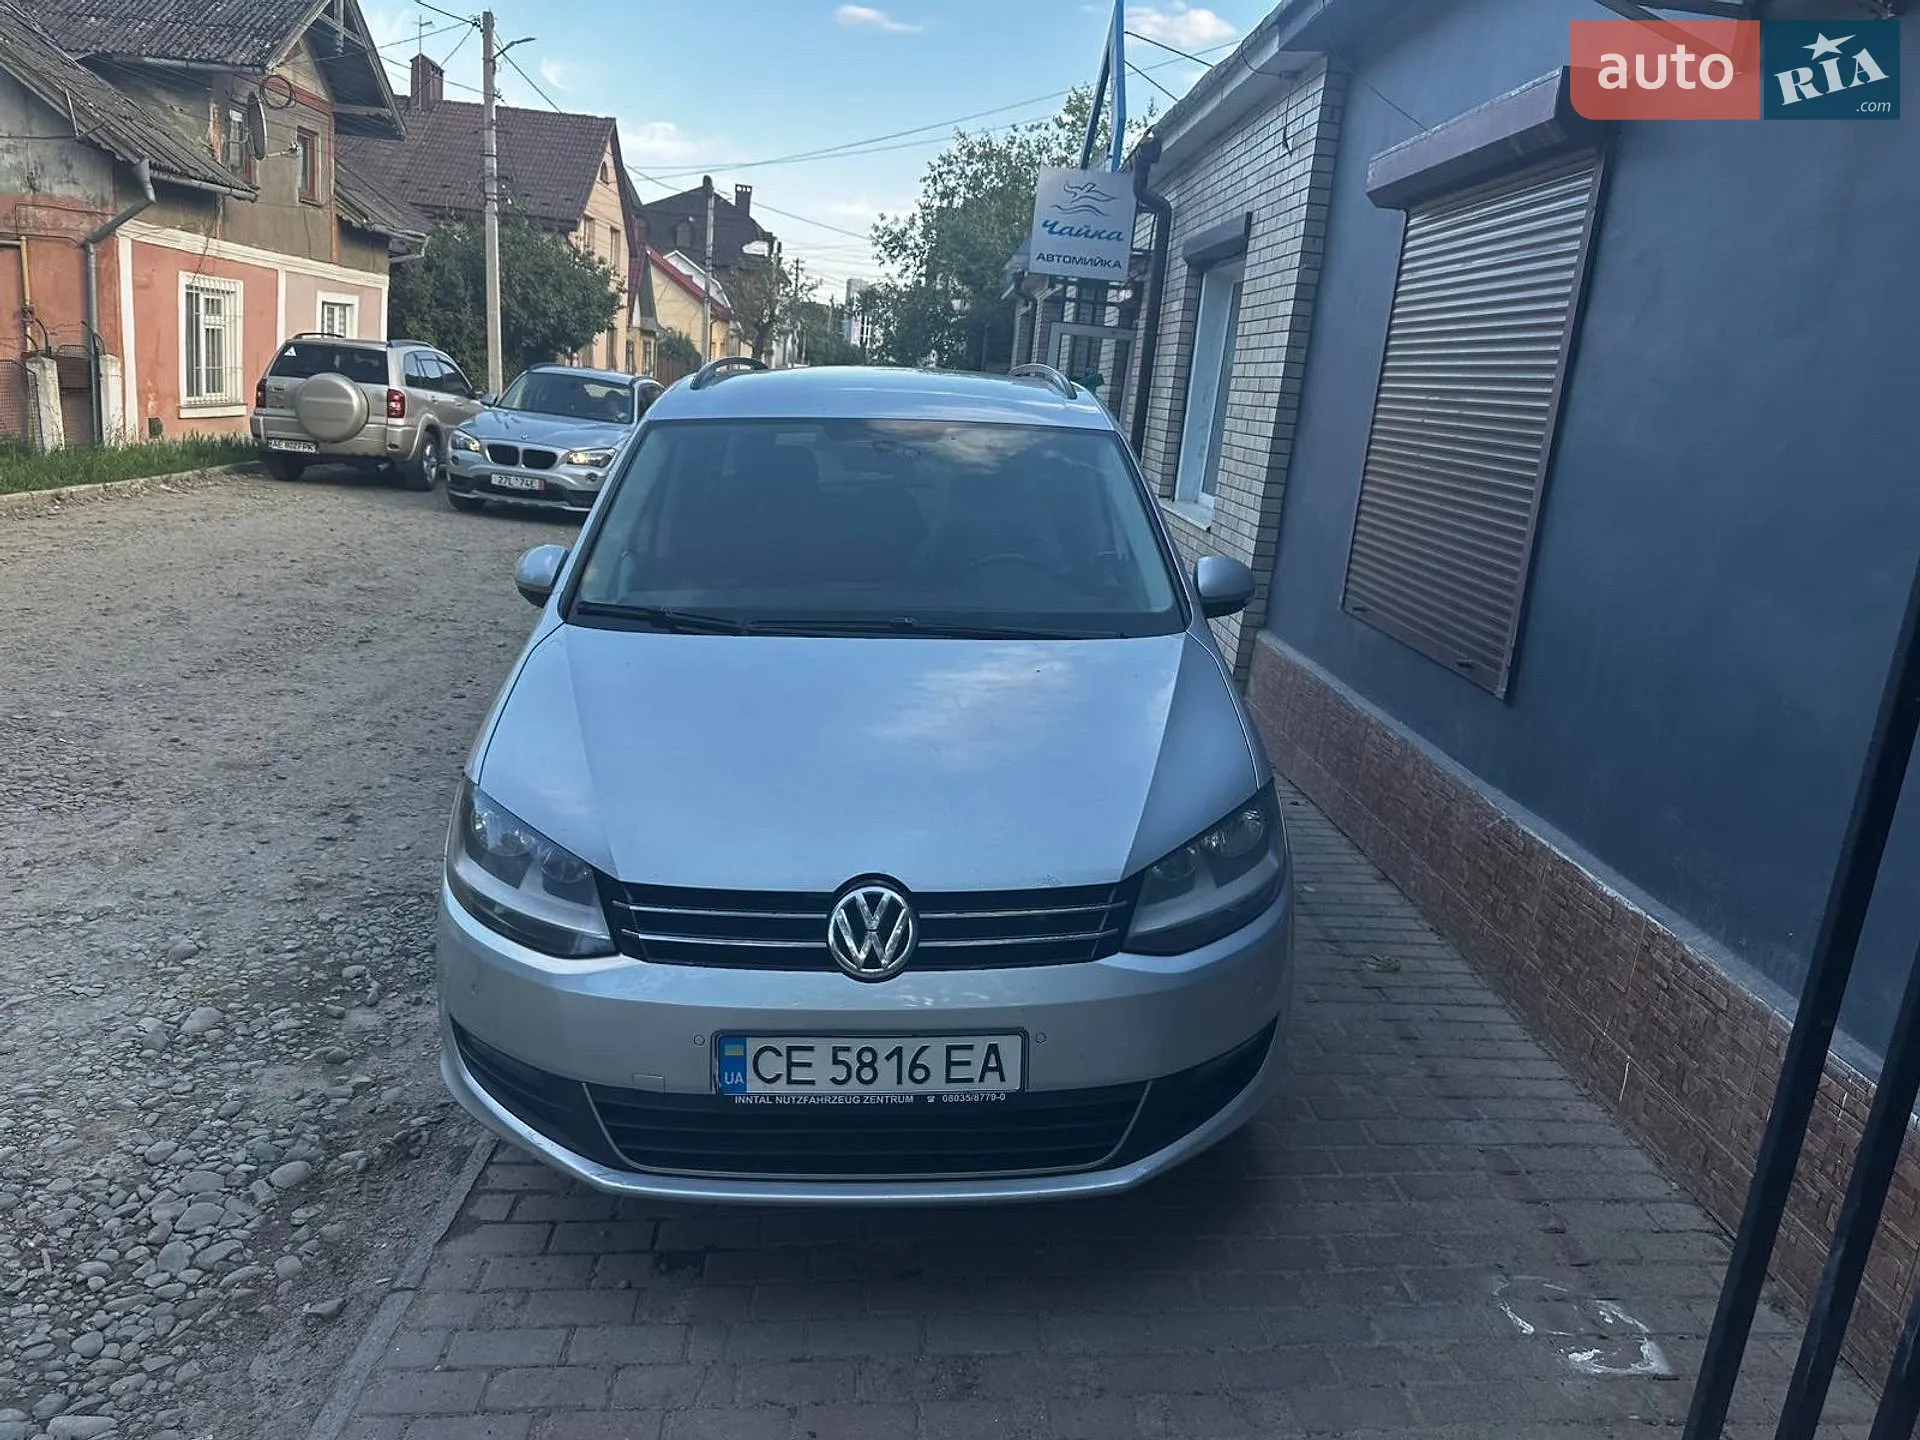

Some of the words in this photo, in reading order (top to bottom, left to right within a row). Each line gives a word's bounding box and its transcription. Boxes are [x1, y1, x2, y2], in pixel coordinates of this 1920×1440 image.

[1041, 219, 1125, 241] Чайка
[1036, 252, 1122, 269] АВТОМИЙКА
[724, 1071, 744, 1085] UA
[752, 1045, 816, 1085] CE
[829, 1045, 931, 1085] 5816
[944, 1043, 1006, 1084] EA
[735, 1095, 773, 1104] INNTAL
[775, 1095, 861, 1104] NUTZFAHRZEUG
[863, 1095, 914, 1104] ZENTRUM
